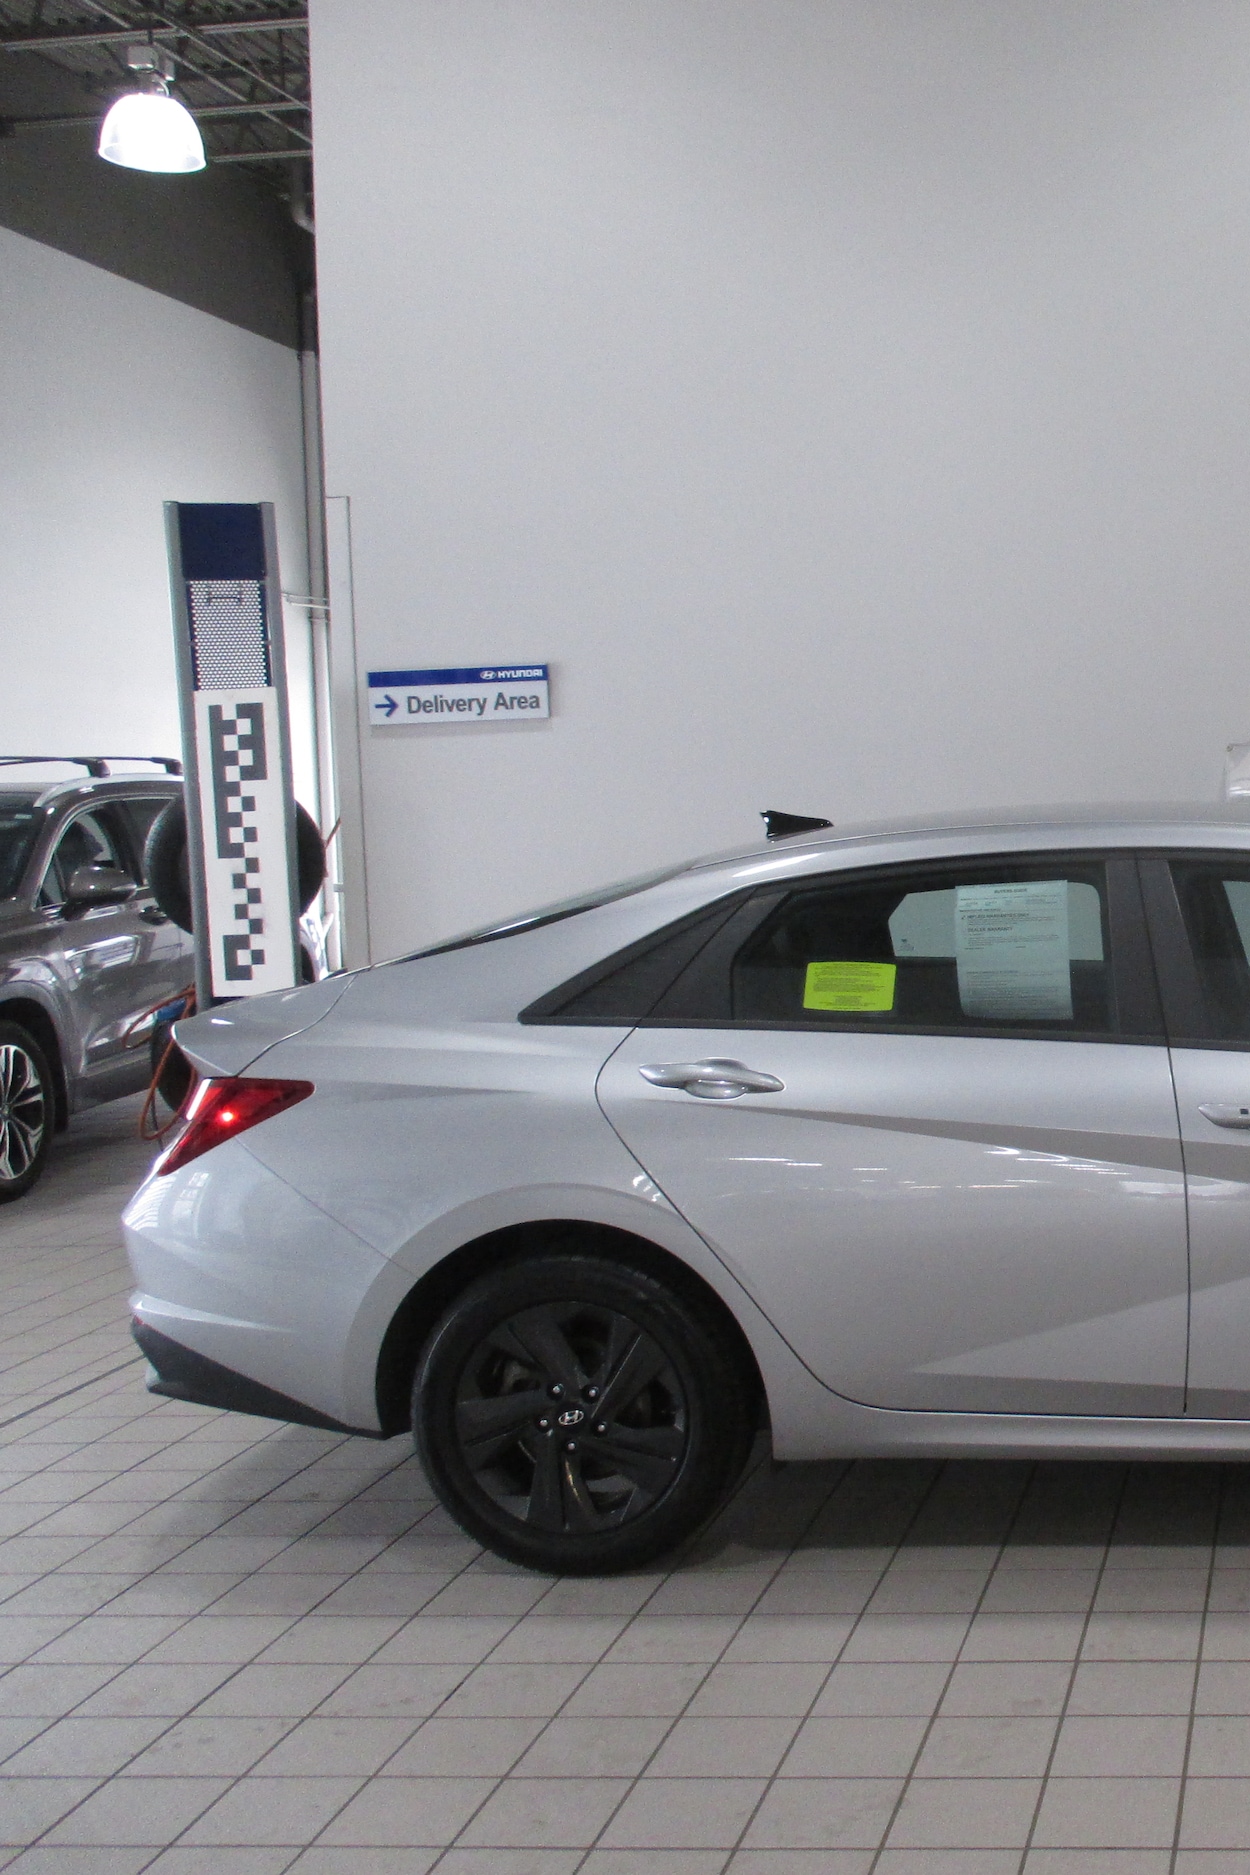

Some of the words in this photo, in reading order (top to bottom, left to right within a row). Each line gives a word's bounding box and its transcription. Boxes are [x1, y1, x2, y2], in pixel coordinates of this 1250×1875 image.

[498, 669, 543, 679] HYUNDAI
[407, 694, 487, 716] Delivery
[494, 692, 540, 711] Area
